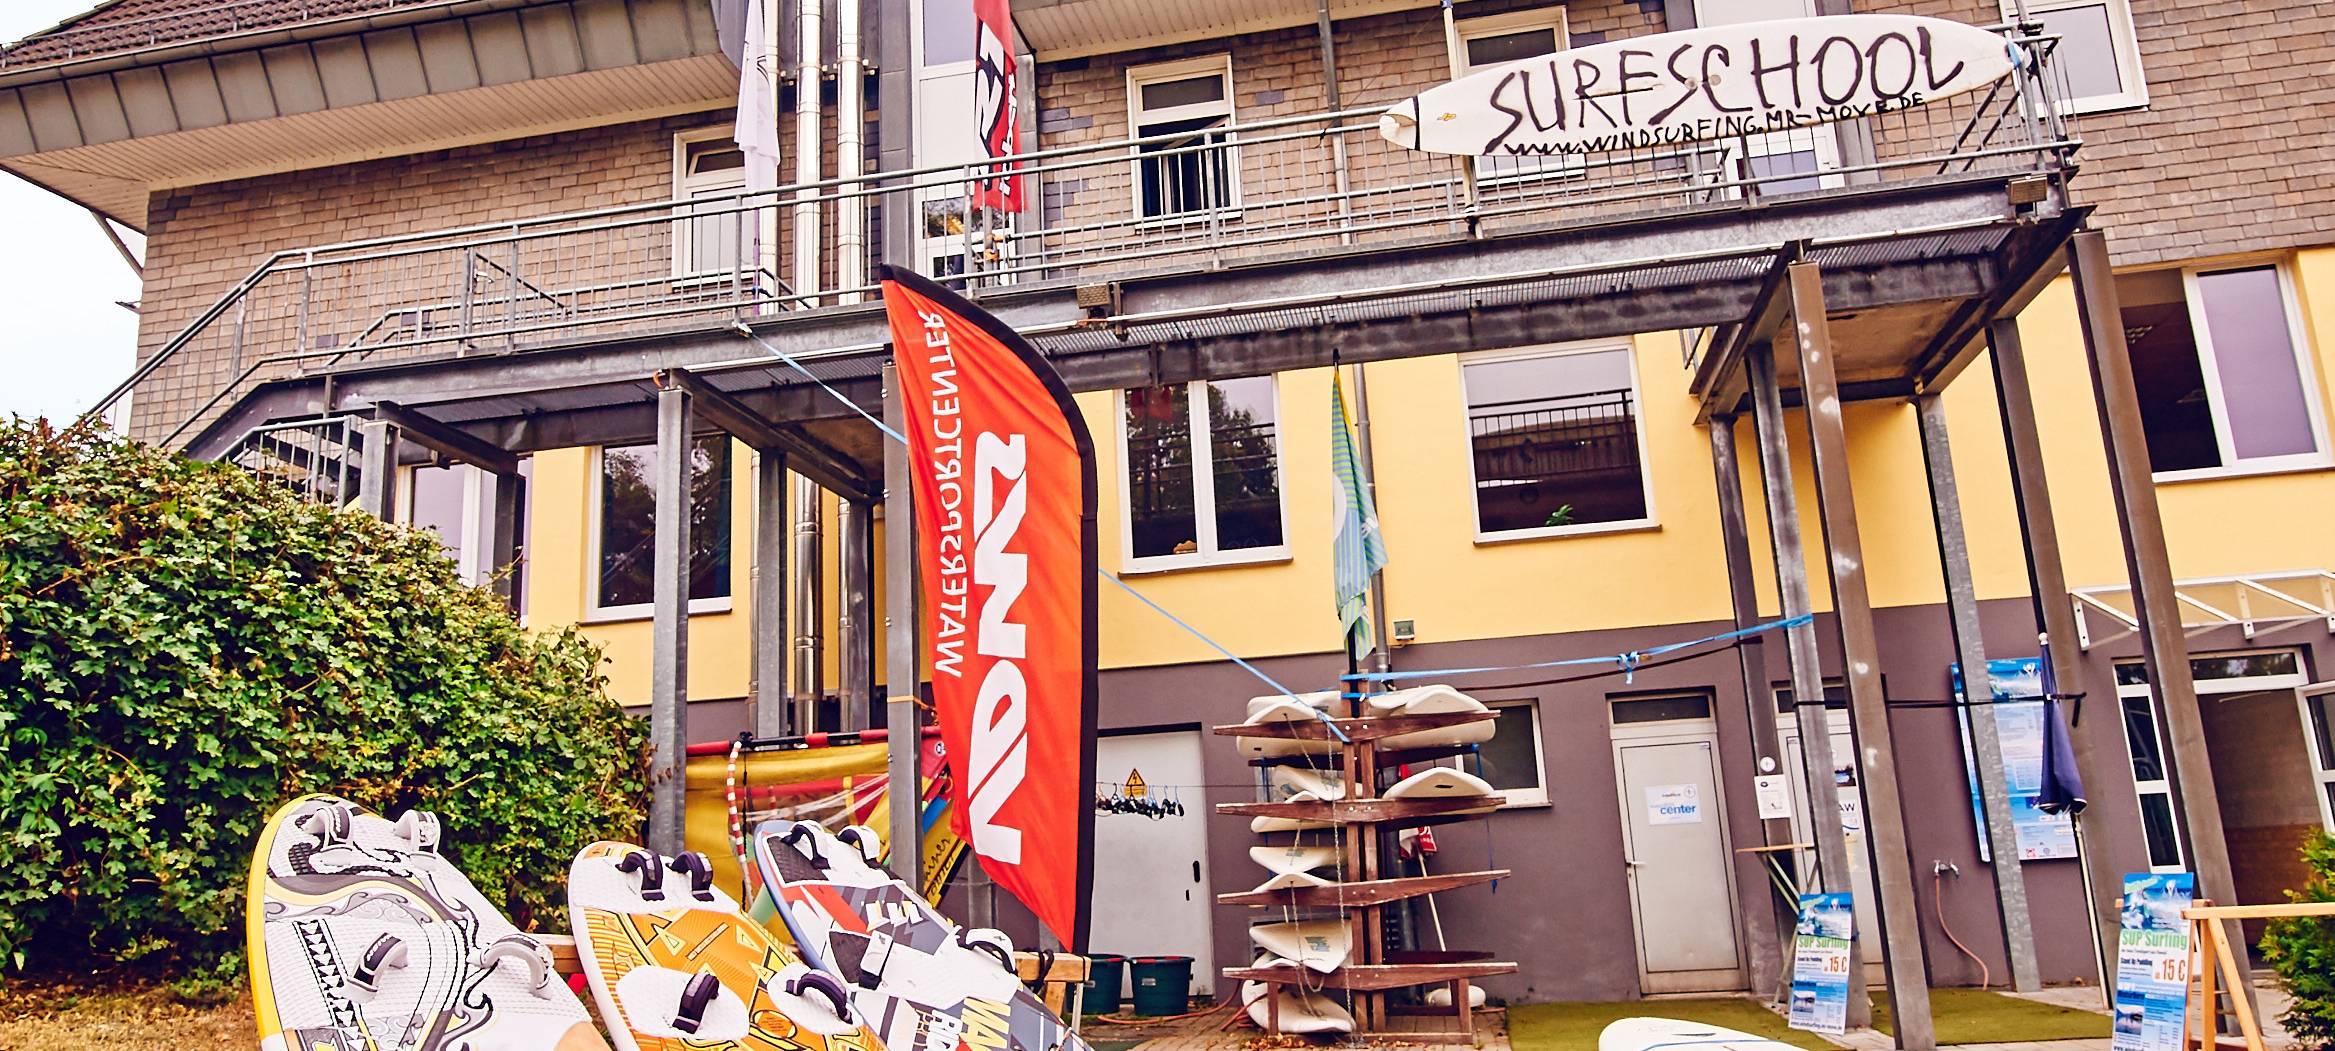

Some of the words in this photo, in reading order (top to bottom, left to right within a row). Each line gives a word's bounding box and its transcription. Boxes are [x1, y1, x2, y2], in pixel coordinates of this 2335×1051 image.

[1485, 26, 1964, 155] SURFSCHOOL
[1660, 804, 1696, 815] center
[2122, 929, 2143, 946] SUP
[2145, 930, 2188, 951] Surfing
[1829, 956, 1839, 973] 15
[2163, 958, 2175, 981] 15
